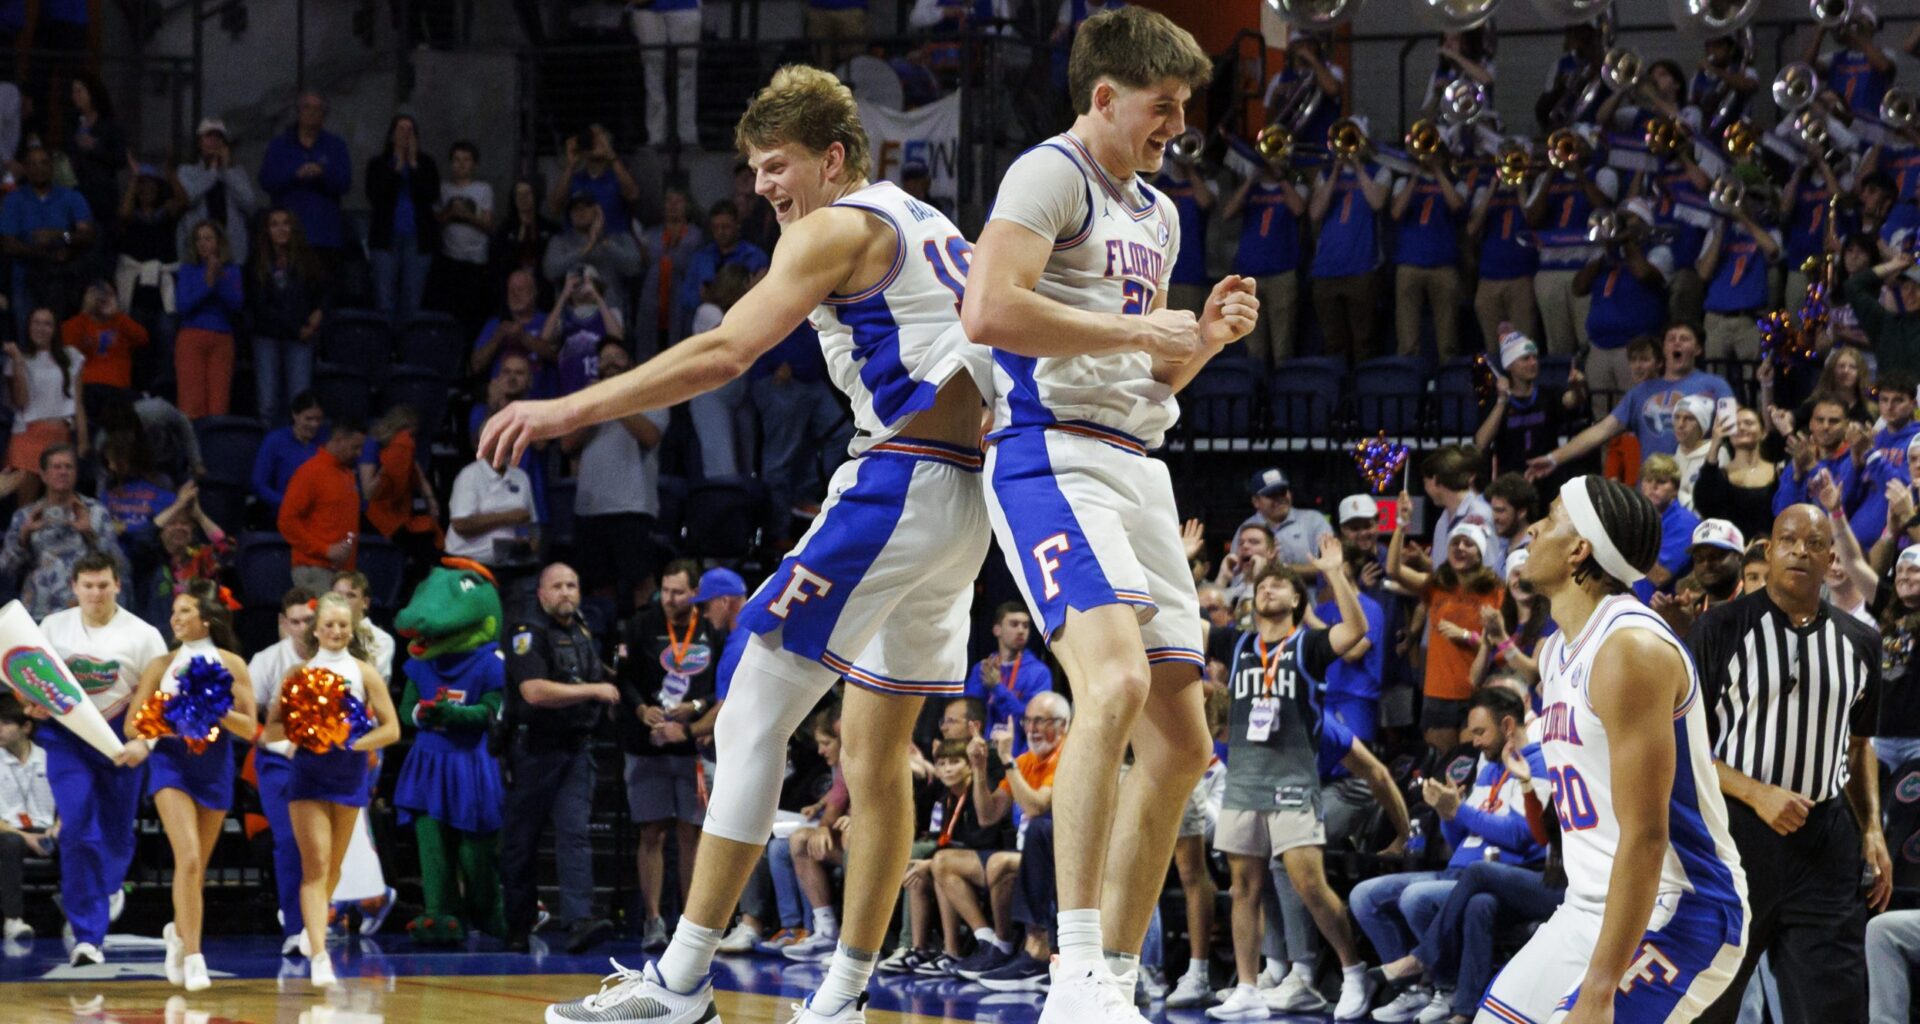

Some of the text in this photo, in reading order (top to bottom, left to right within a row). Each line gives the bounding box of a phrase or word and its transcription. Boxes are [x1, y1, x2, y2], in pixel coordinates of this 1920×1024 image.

[1103, 239, 1164, 289] FLORID
[768, 563, 833, 620] F
[1033, 532, 1071, 601] F
[1537, 700, 1585, 748] LORIDA
[1548, 763, 1599, 833] 20
[1617, 941, 1680, 996] F
